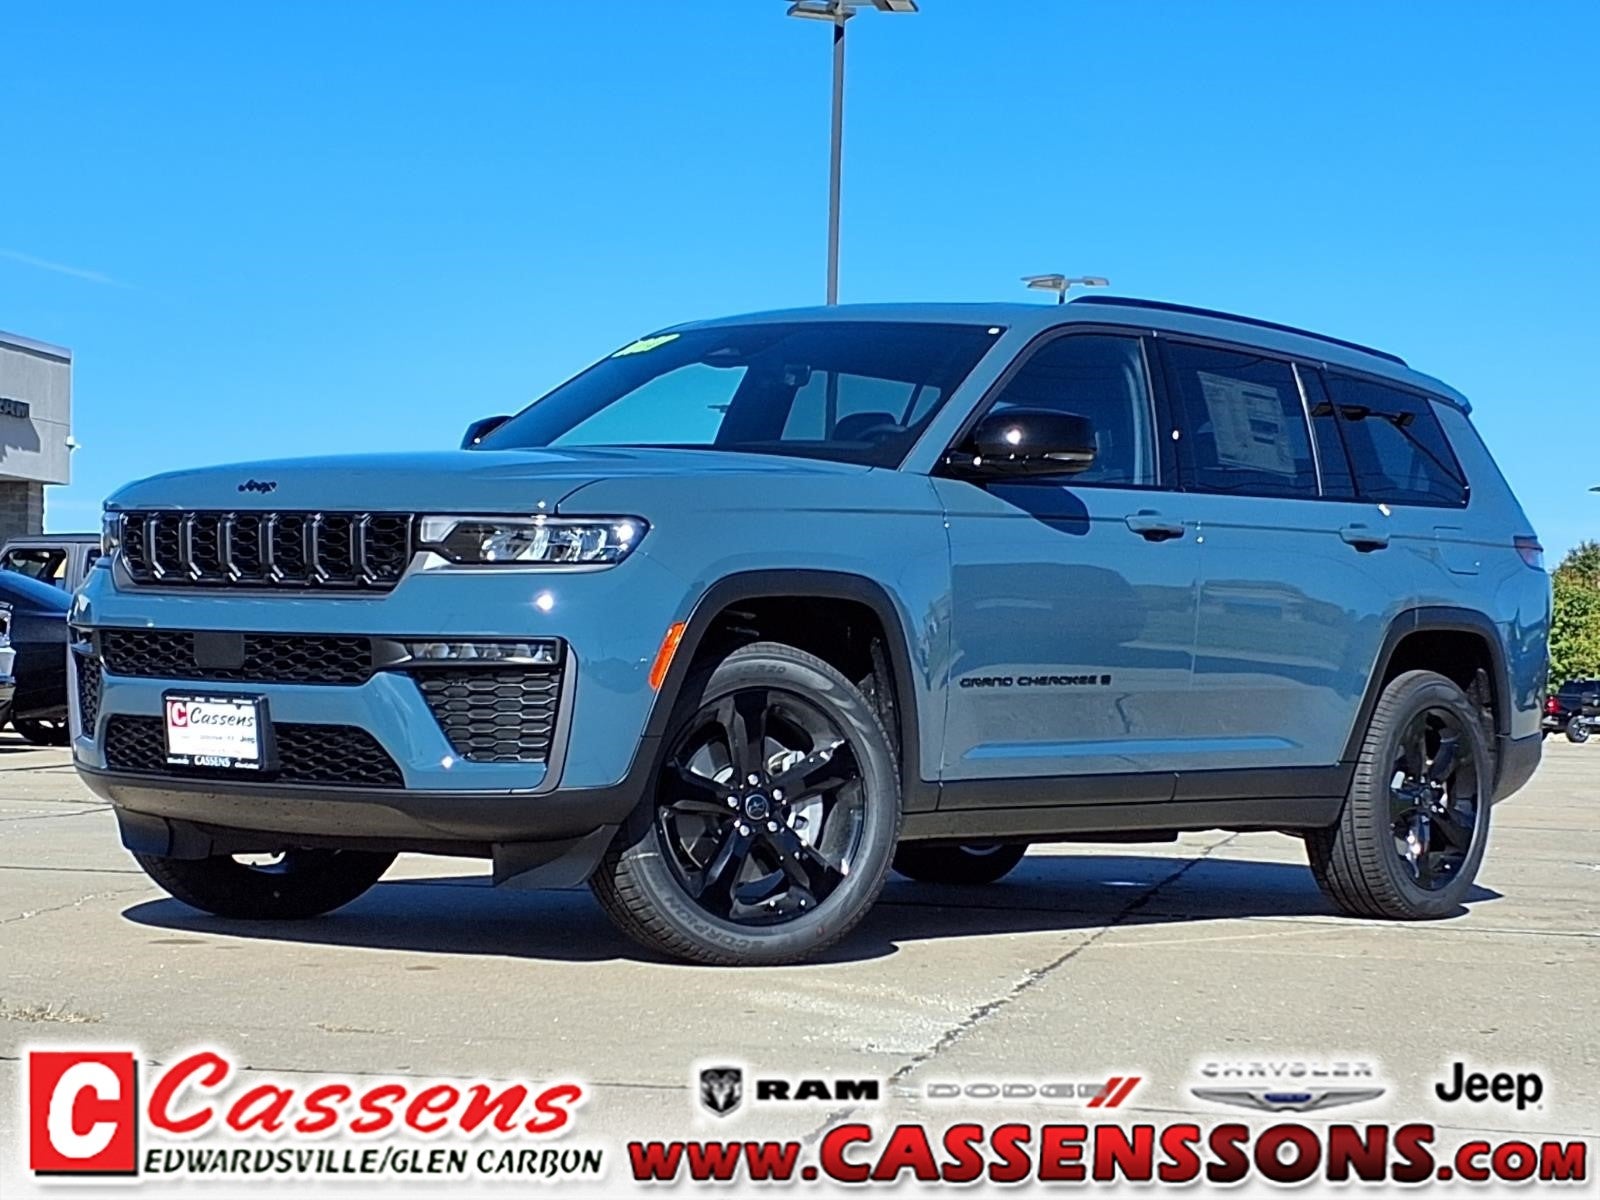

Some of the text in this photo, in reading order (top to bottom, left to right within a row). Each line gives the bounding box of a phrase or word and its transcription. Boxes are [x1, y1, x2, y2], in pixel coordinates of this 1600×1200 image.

[959, 677, 1013, 688] GRAND
[1017, 675, 1097, 687] CHEROKEE
[190, 706, 255, 727] Cassens
[194, 755, 231, 768] CASSENS
